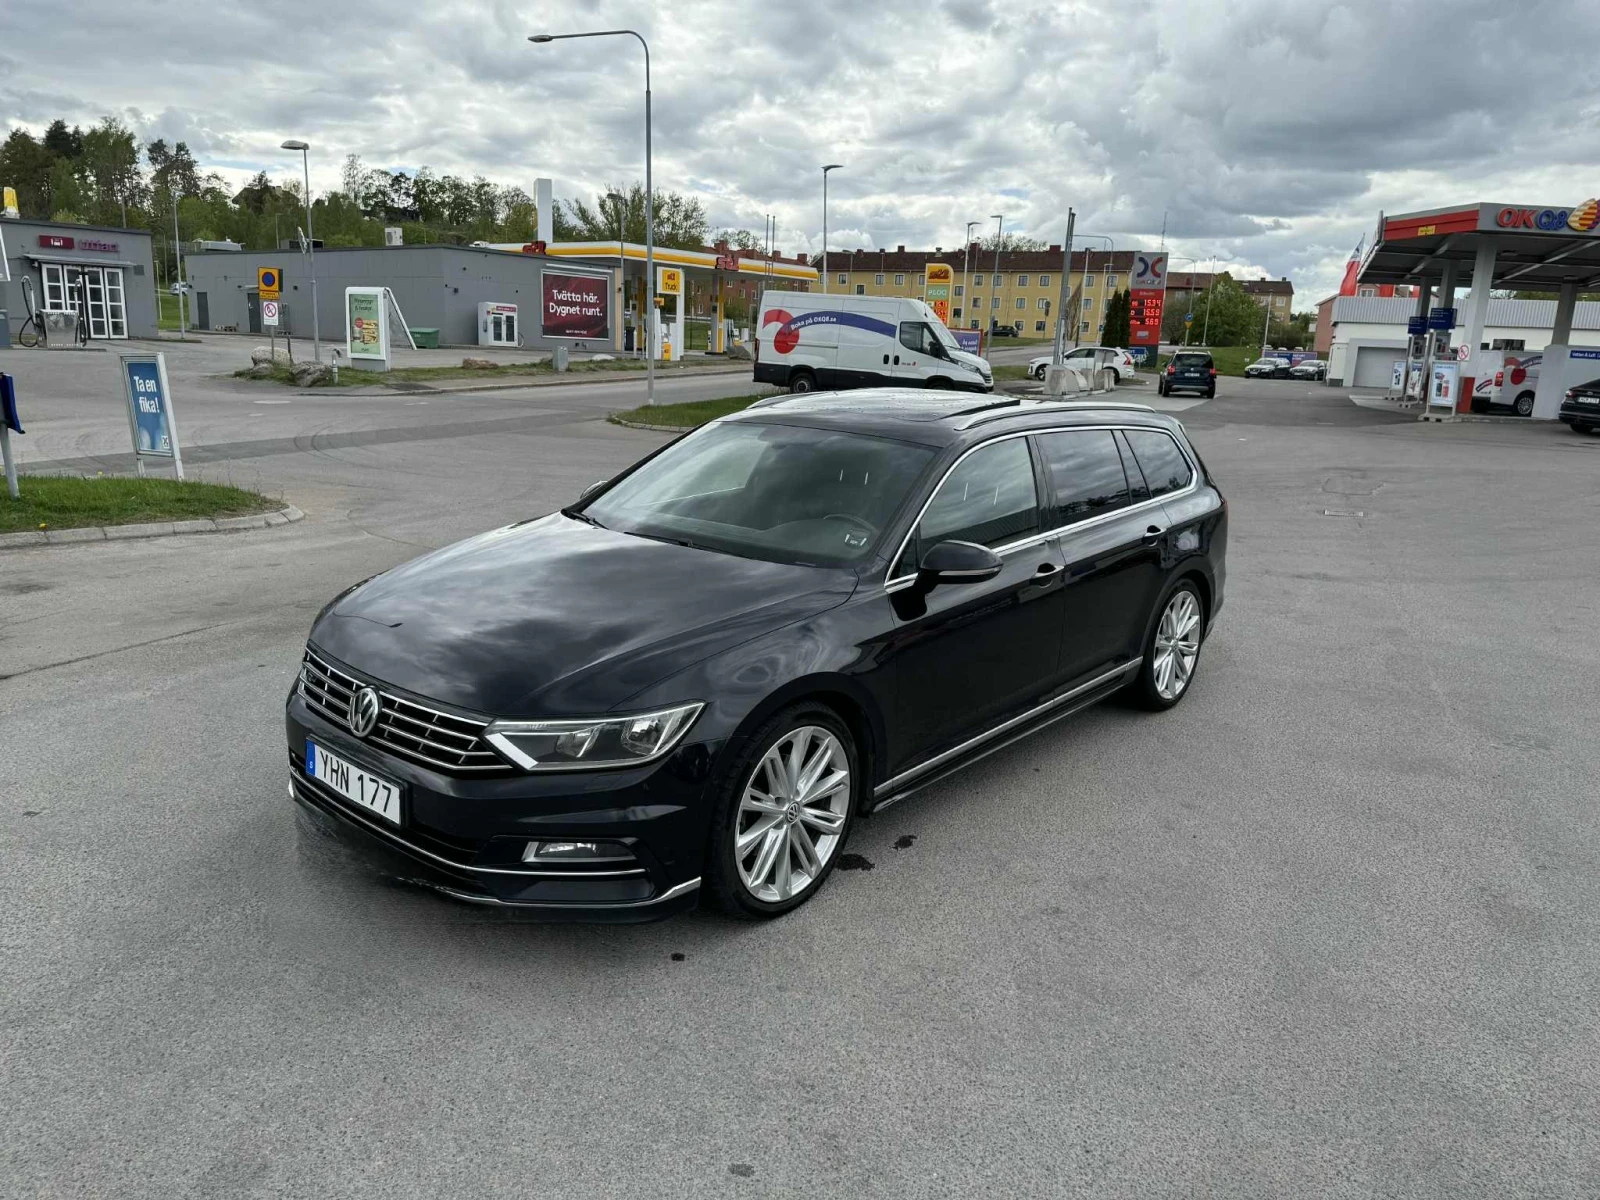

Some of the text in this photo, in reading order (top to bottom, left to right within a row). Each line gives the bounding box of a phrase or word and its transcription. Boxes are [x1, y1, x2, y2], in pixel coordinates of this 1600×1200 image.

[552, 289, 600, 303] Tvätta här.
[549, 302, 603, 317] Dygnet runt.
[133, 376, 157, 392] Ta en
[139, 397, 160, 413] fika!
[319, 750, 392, 812] YHN 177
